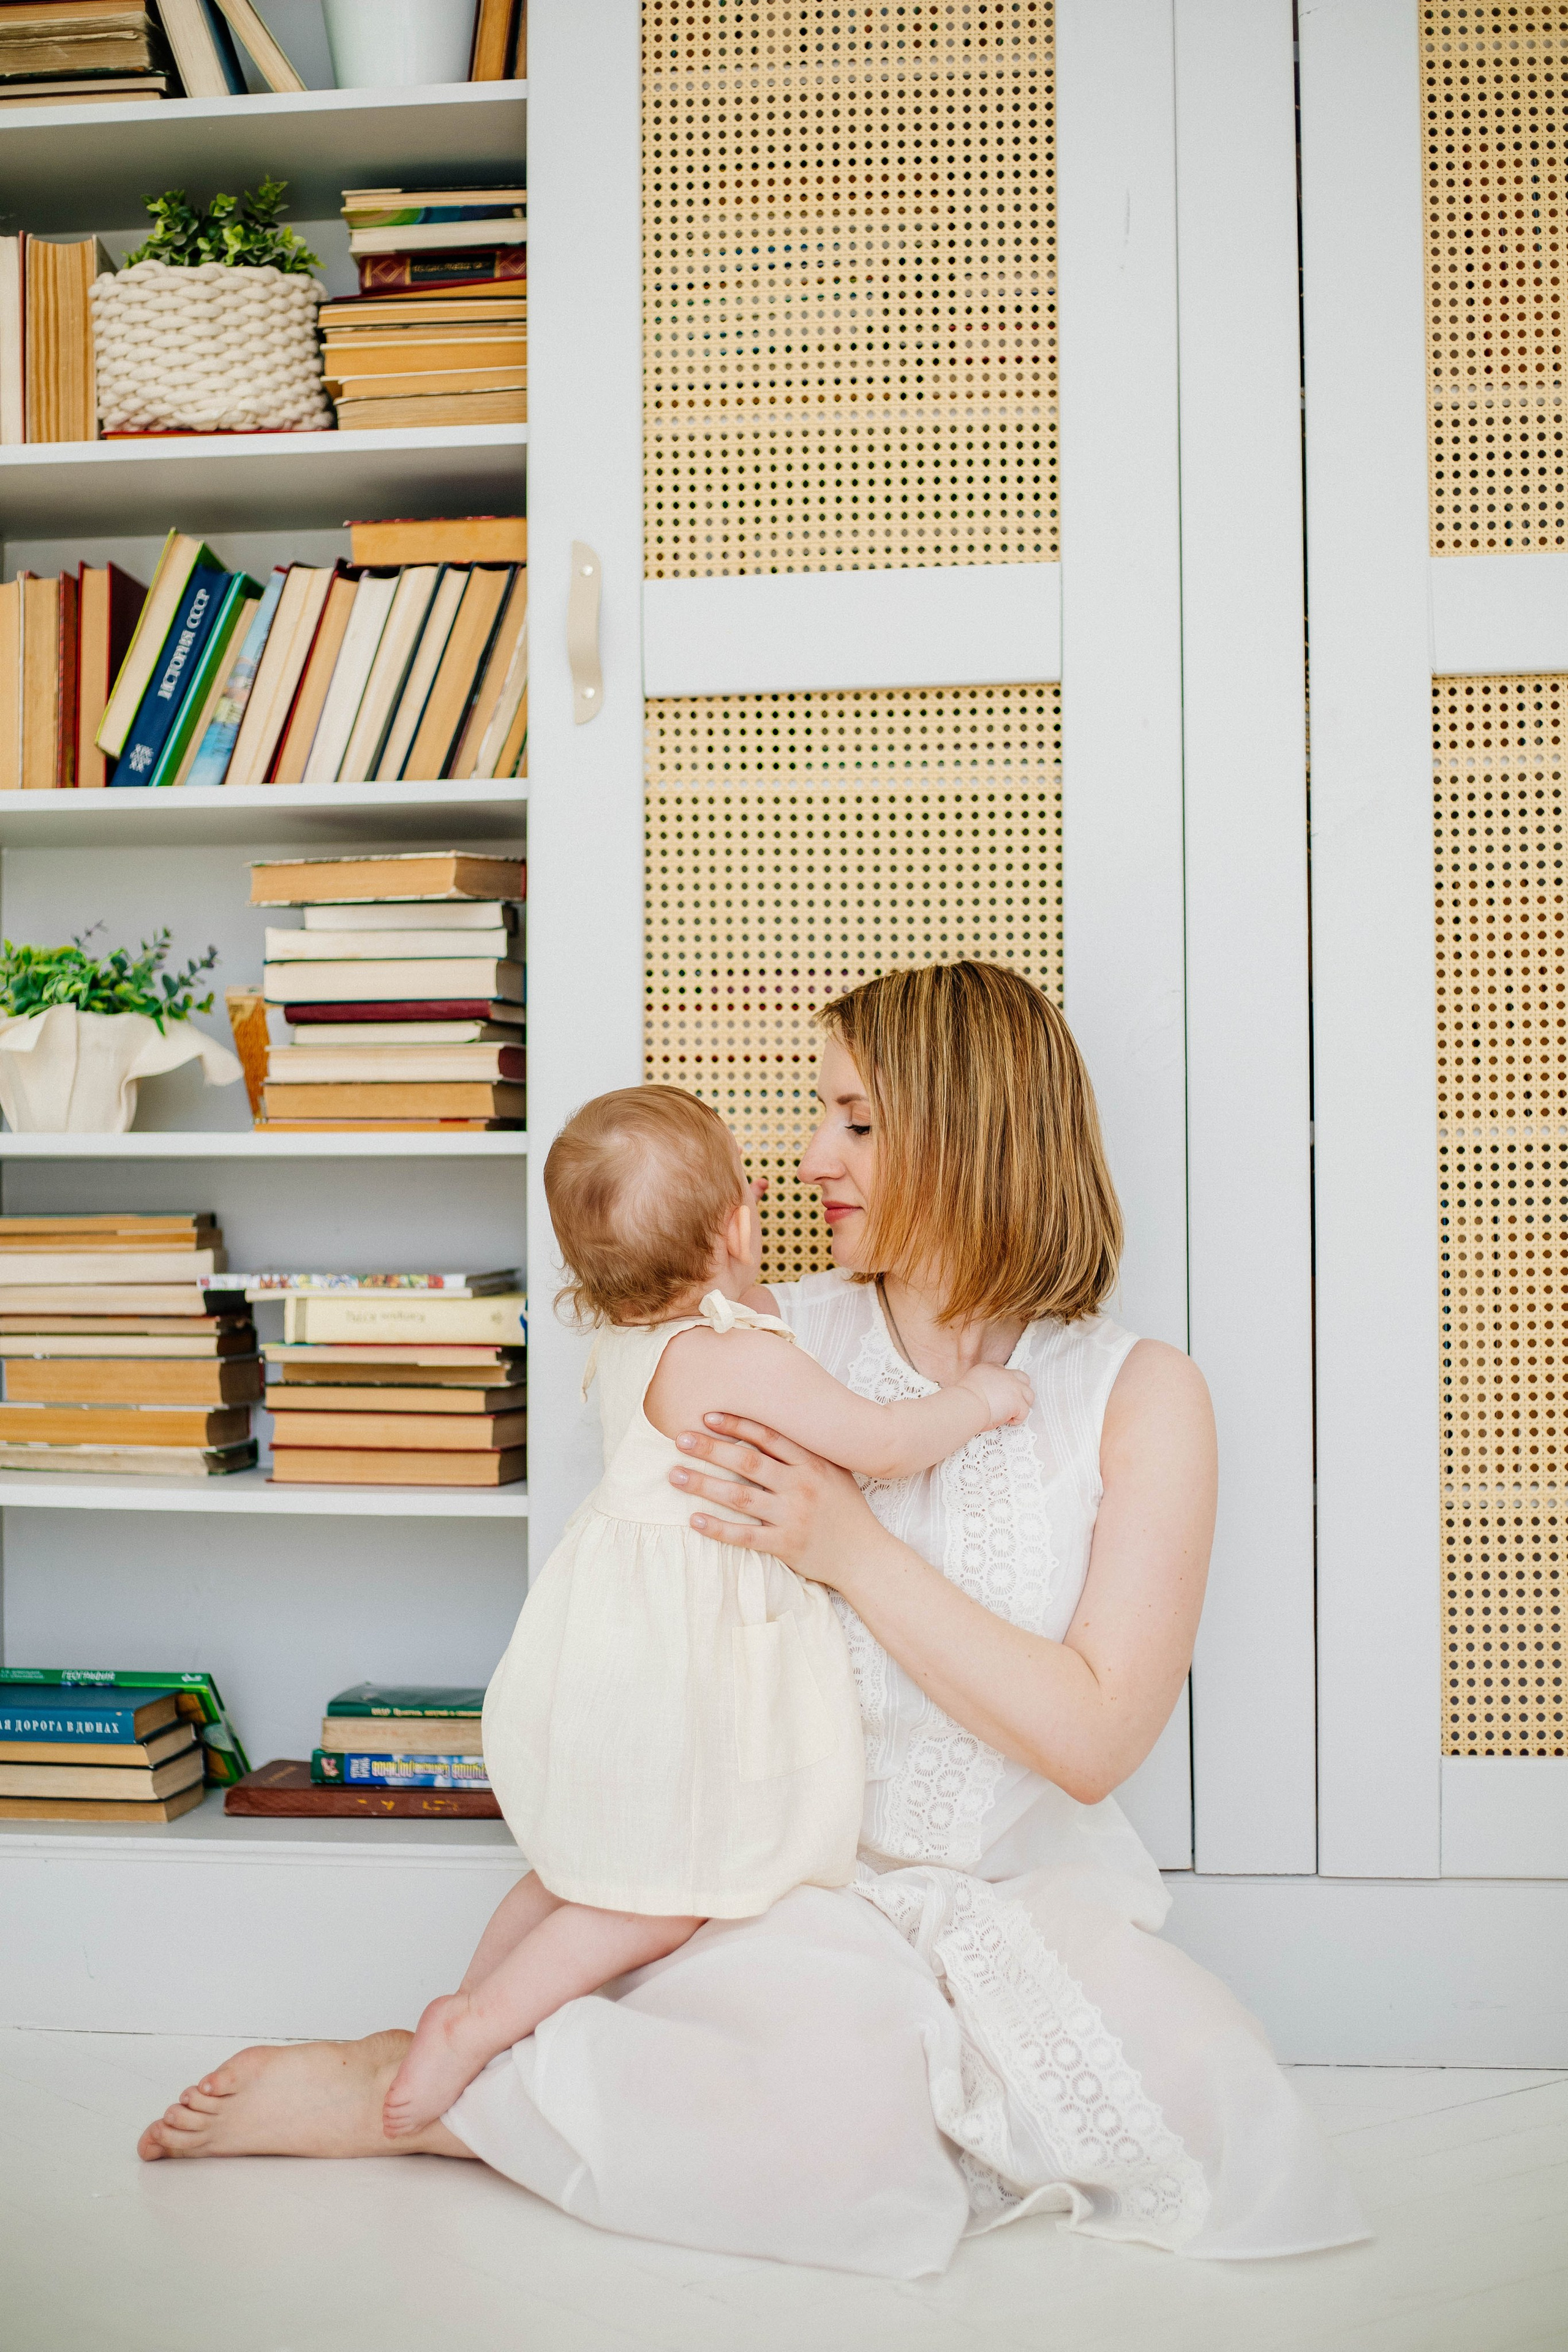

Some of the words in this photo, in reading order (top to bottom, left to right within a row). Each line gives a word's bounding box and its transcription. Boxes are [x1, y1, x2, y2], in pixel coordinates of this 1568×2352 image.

[157, 629, 196, 701] ИСТОРИЯ
[187, 589, 210, 629] СССР
[15, 1719, 63, 1733] ДОРОГА
[67, 1721, 74, 1732] В
[76, 1721, 119, 1735] ДЮНАХ
